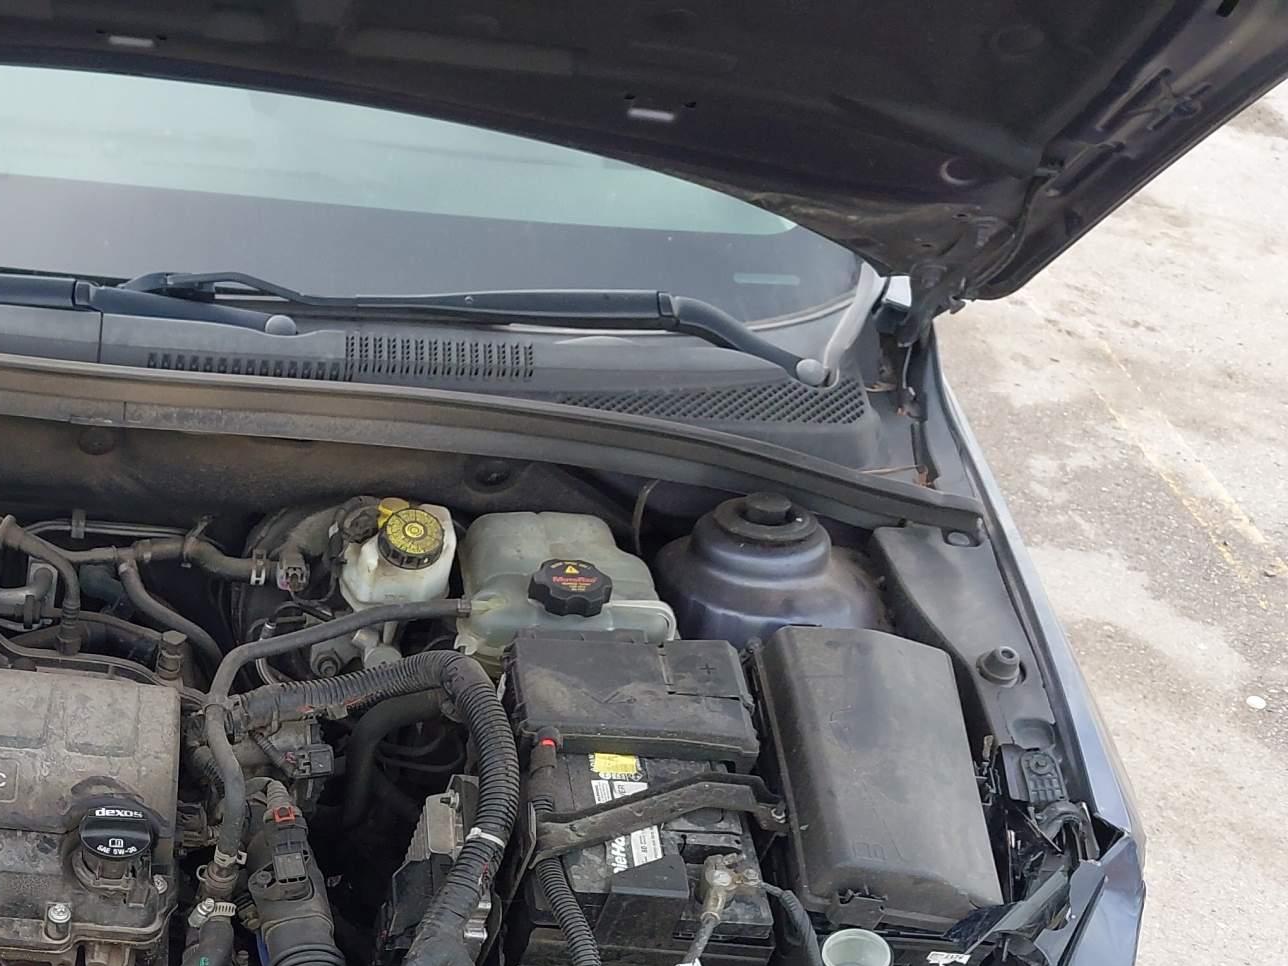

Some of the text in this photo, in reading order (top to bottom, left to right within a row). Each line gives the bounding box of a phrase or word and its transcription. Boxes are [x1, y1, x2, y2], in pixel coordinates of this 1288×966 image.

[95, 807, 143, 818] dexos
[97, 844, 138, 855] SAE 5W-30
